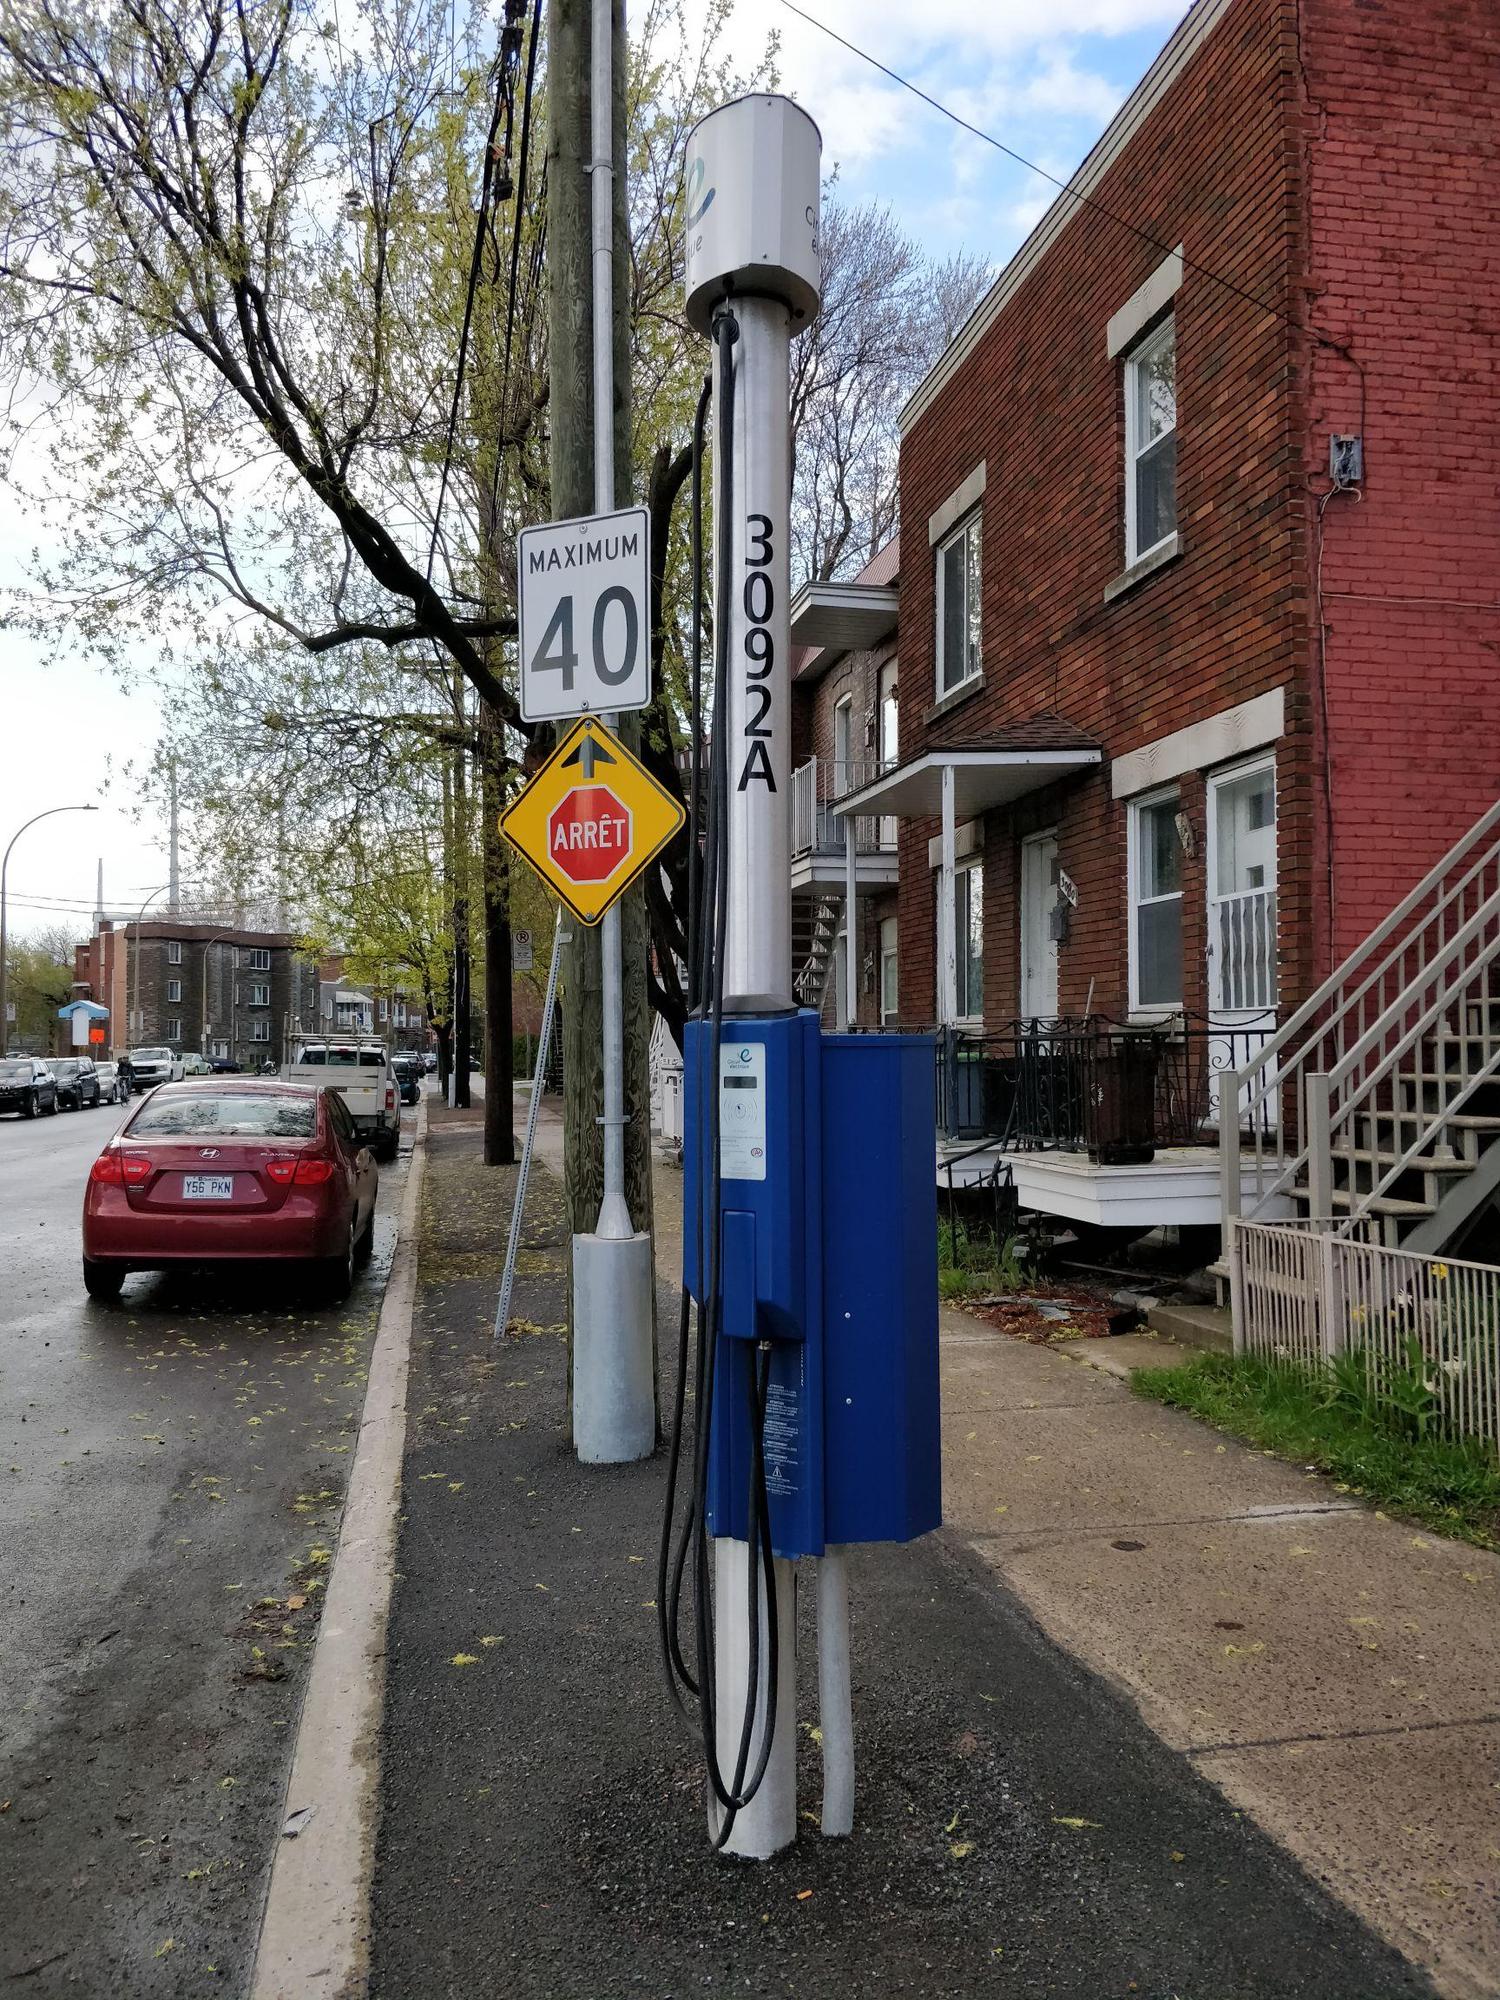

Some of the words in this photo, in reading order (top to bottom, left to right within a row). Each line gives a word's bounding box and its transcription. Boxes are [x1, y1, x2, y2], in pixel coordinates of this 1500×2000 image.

[529, 533, 638, 574] MAXIMUM
[531, 585, 639, 691] 40
[737, 514, 777, 793] 3092A
[553, 813, 626, 851] ARRÊT
[186, 1181, 205, 1193] Y56
[211, 1181, 231, 1193] PKN
